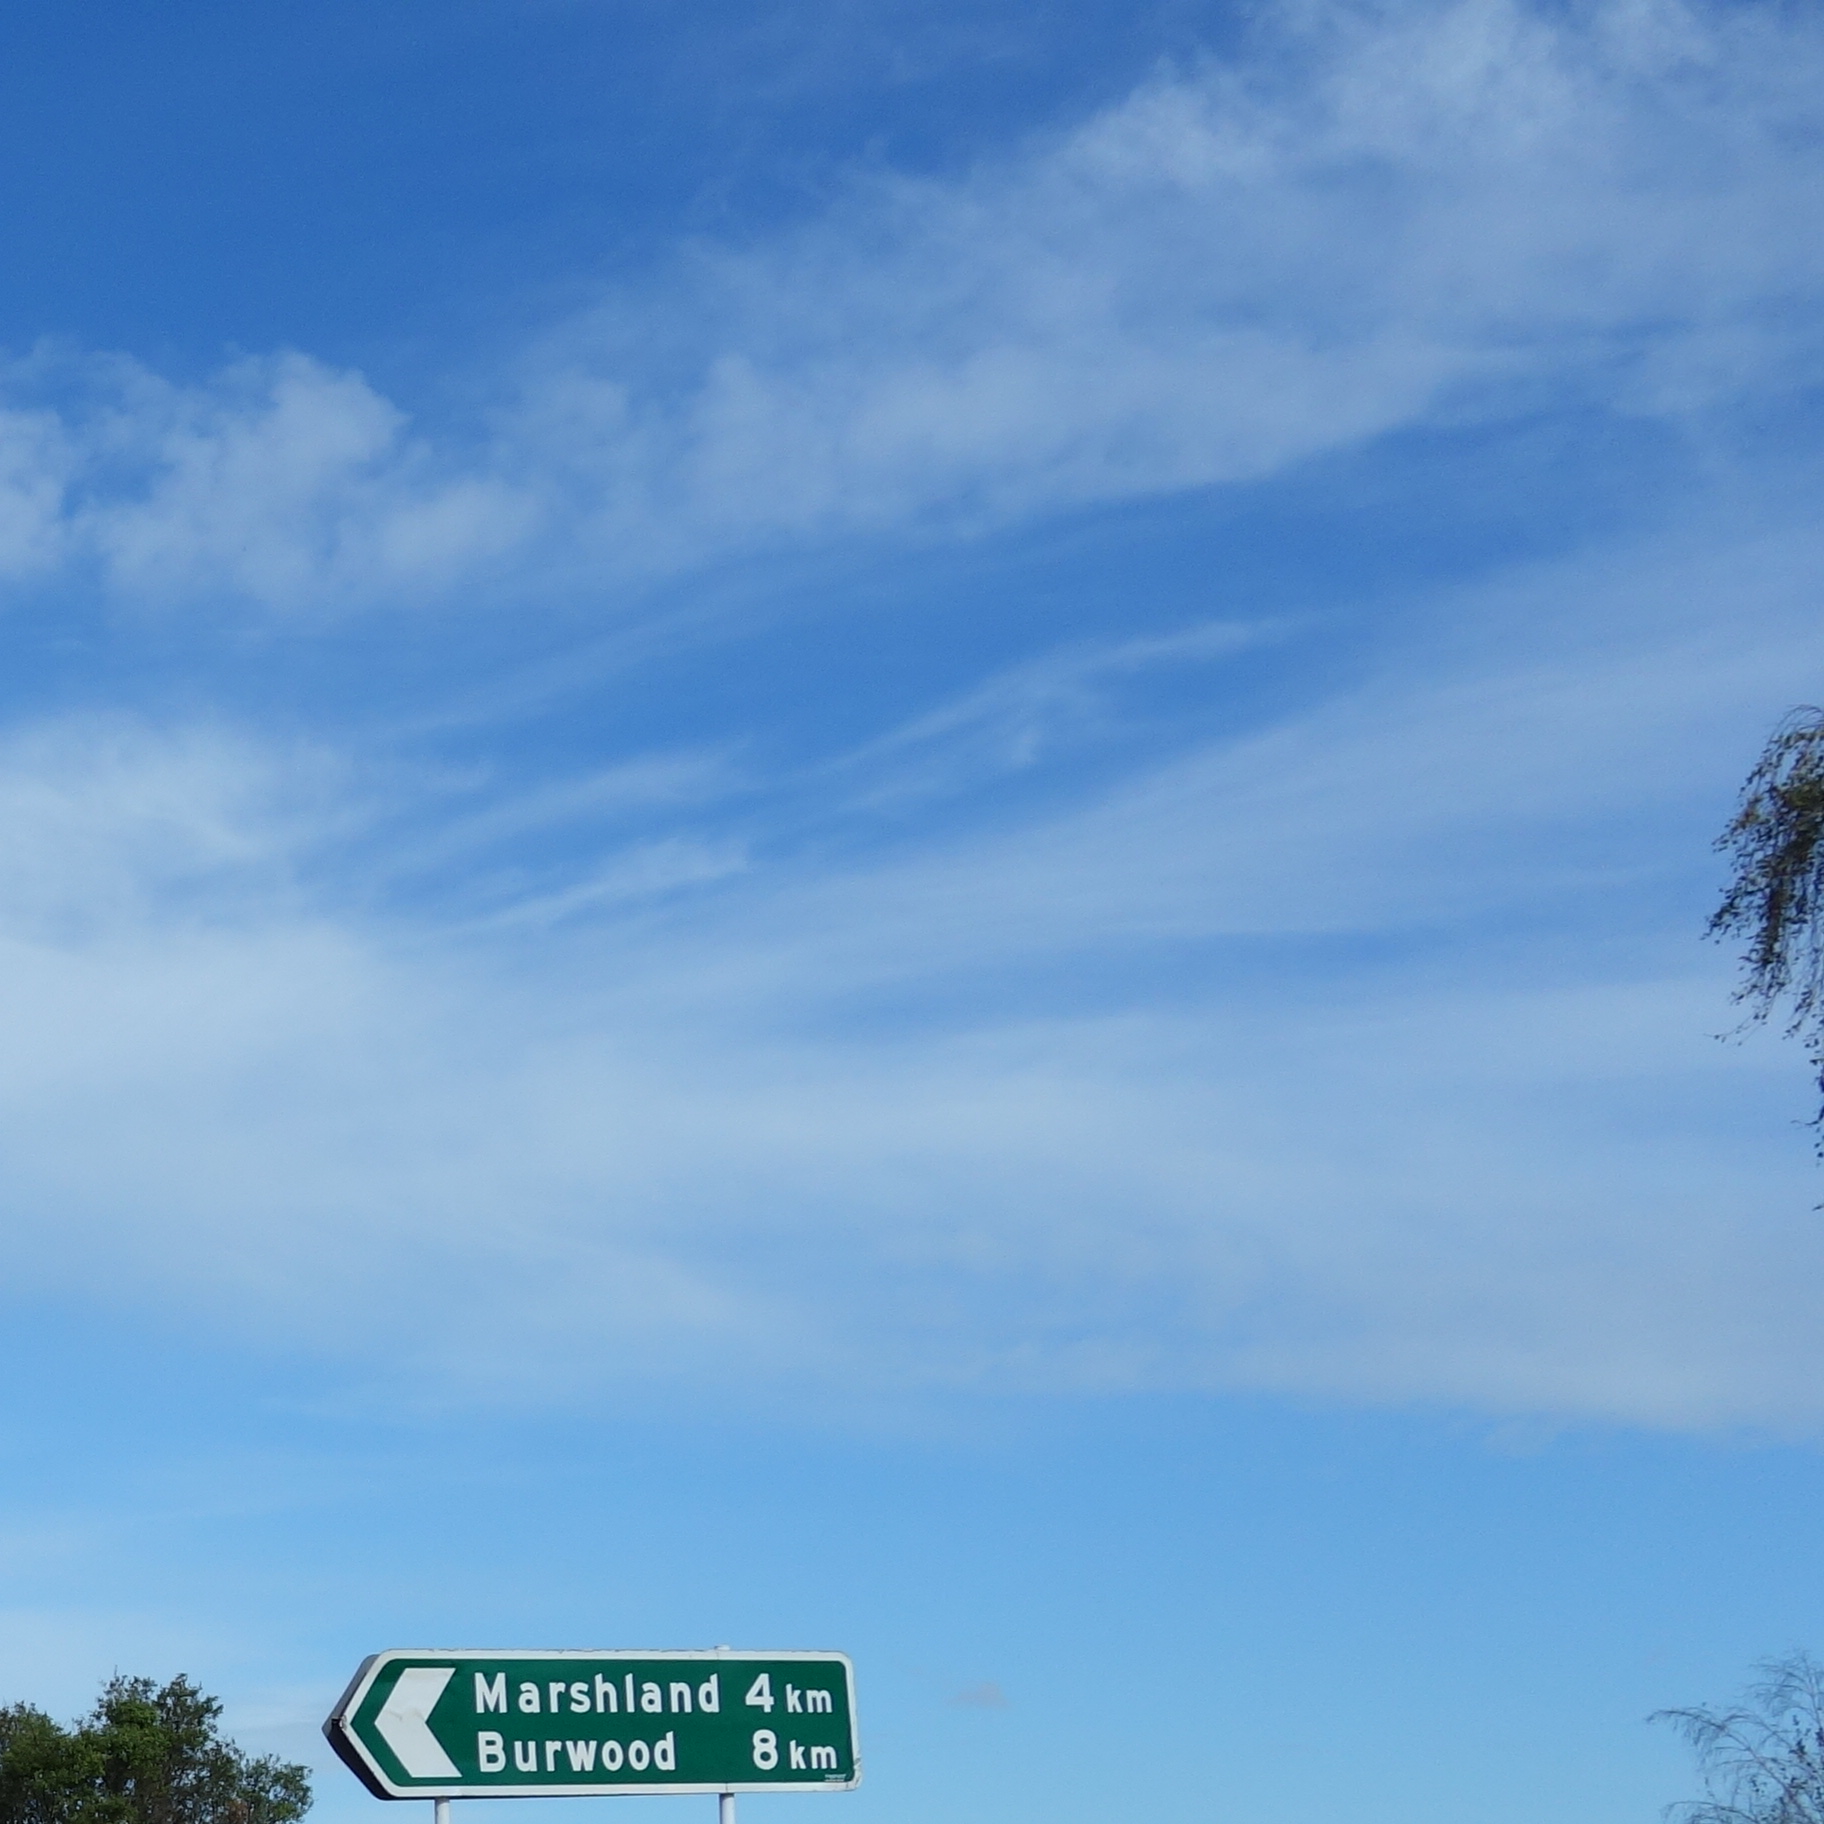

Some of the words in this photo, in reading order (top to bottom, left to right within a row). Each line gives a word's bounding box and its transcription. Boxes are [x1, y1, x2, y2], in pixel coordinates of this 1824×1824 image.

[474, 1672, 720, 1714] Marshland
[744, 1672, 775, 1711] 4
[785, 1682, 834, 1714] km
[478, 1731, 677, 1773] Burwood
[751, 1729, 779, 1770] 8
[789, 1739, 838, 1770] km
